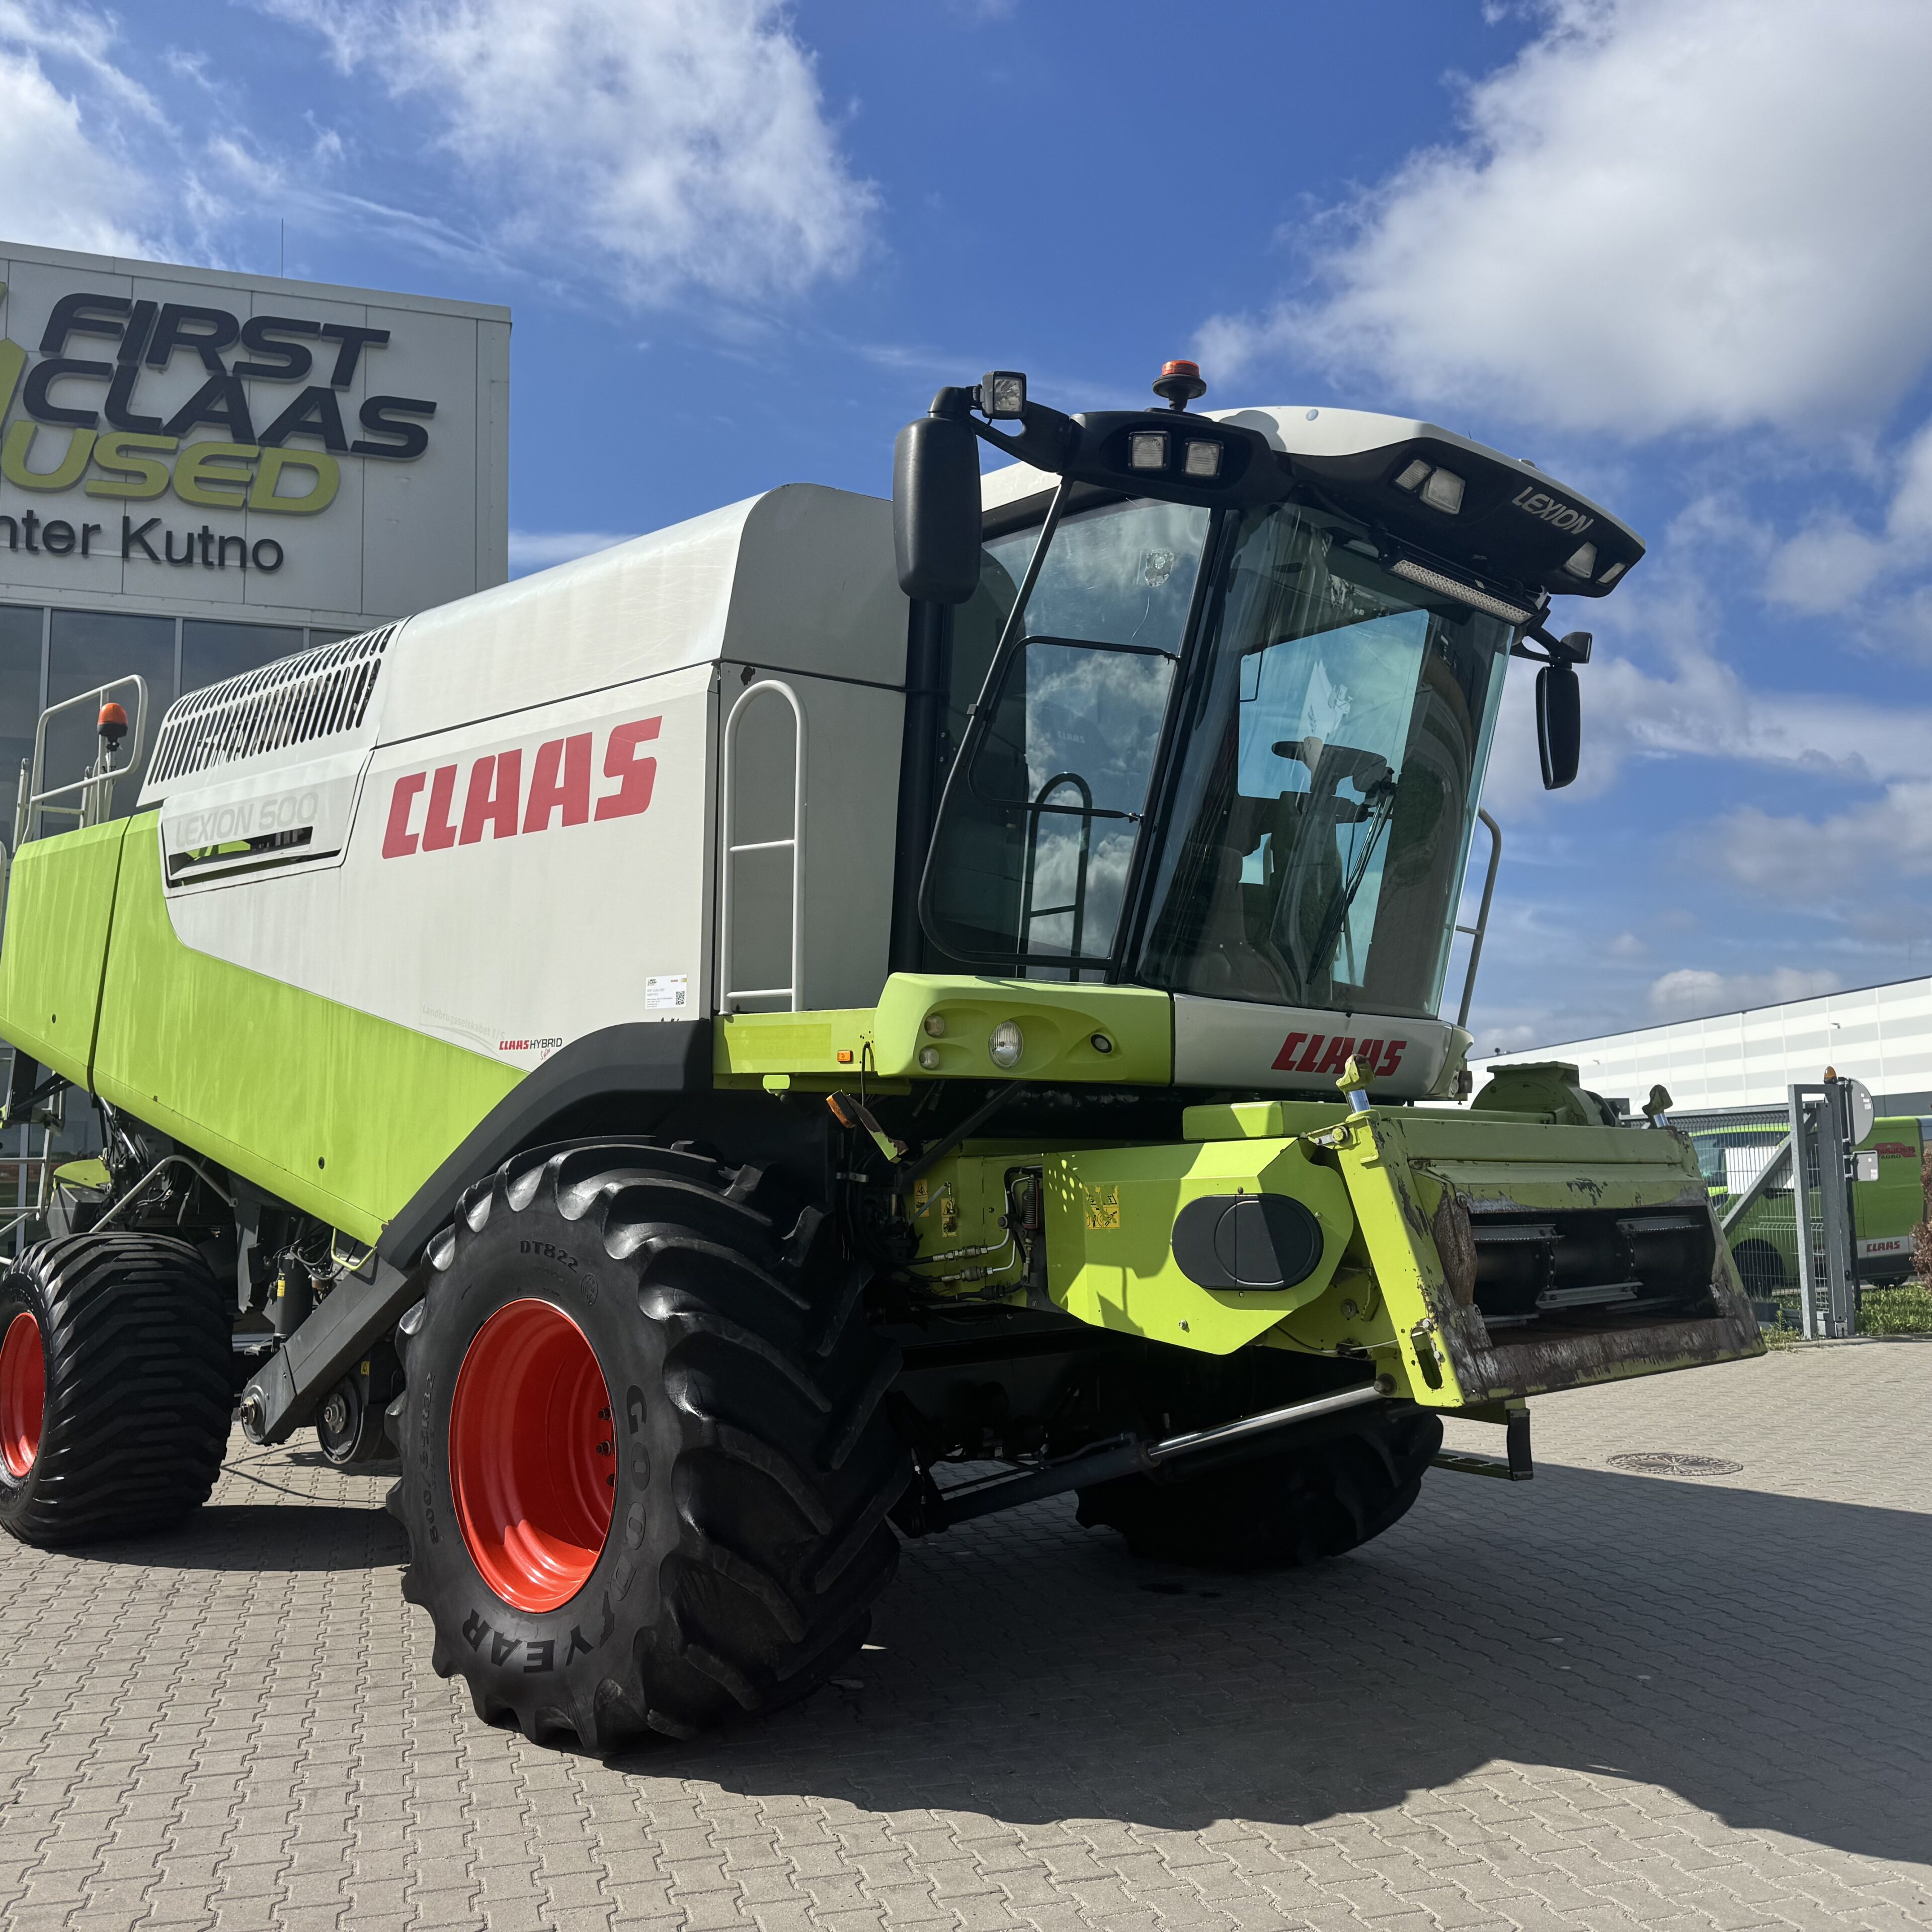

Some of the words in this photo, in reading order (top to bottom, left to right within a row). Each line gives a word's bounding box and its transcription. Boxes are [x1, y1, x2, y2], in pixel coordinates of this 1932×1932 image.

[39, 293, 390, 390] FIRST
[23, 358, 437, 462] CLAAS
[1, 420, 340, 515] USED
[1512, 486, 1594, 535] LEXION
[122, 516, 284, 572] Kutno
[382, 715, 663, 859] CLAAS
[176, 803, 254, 848] LEXION
[520, 1239, 578, 1273] DT822
[1867, 1241, 1900, 1252] CLAAS
